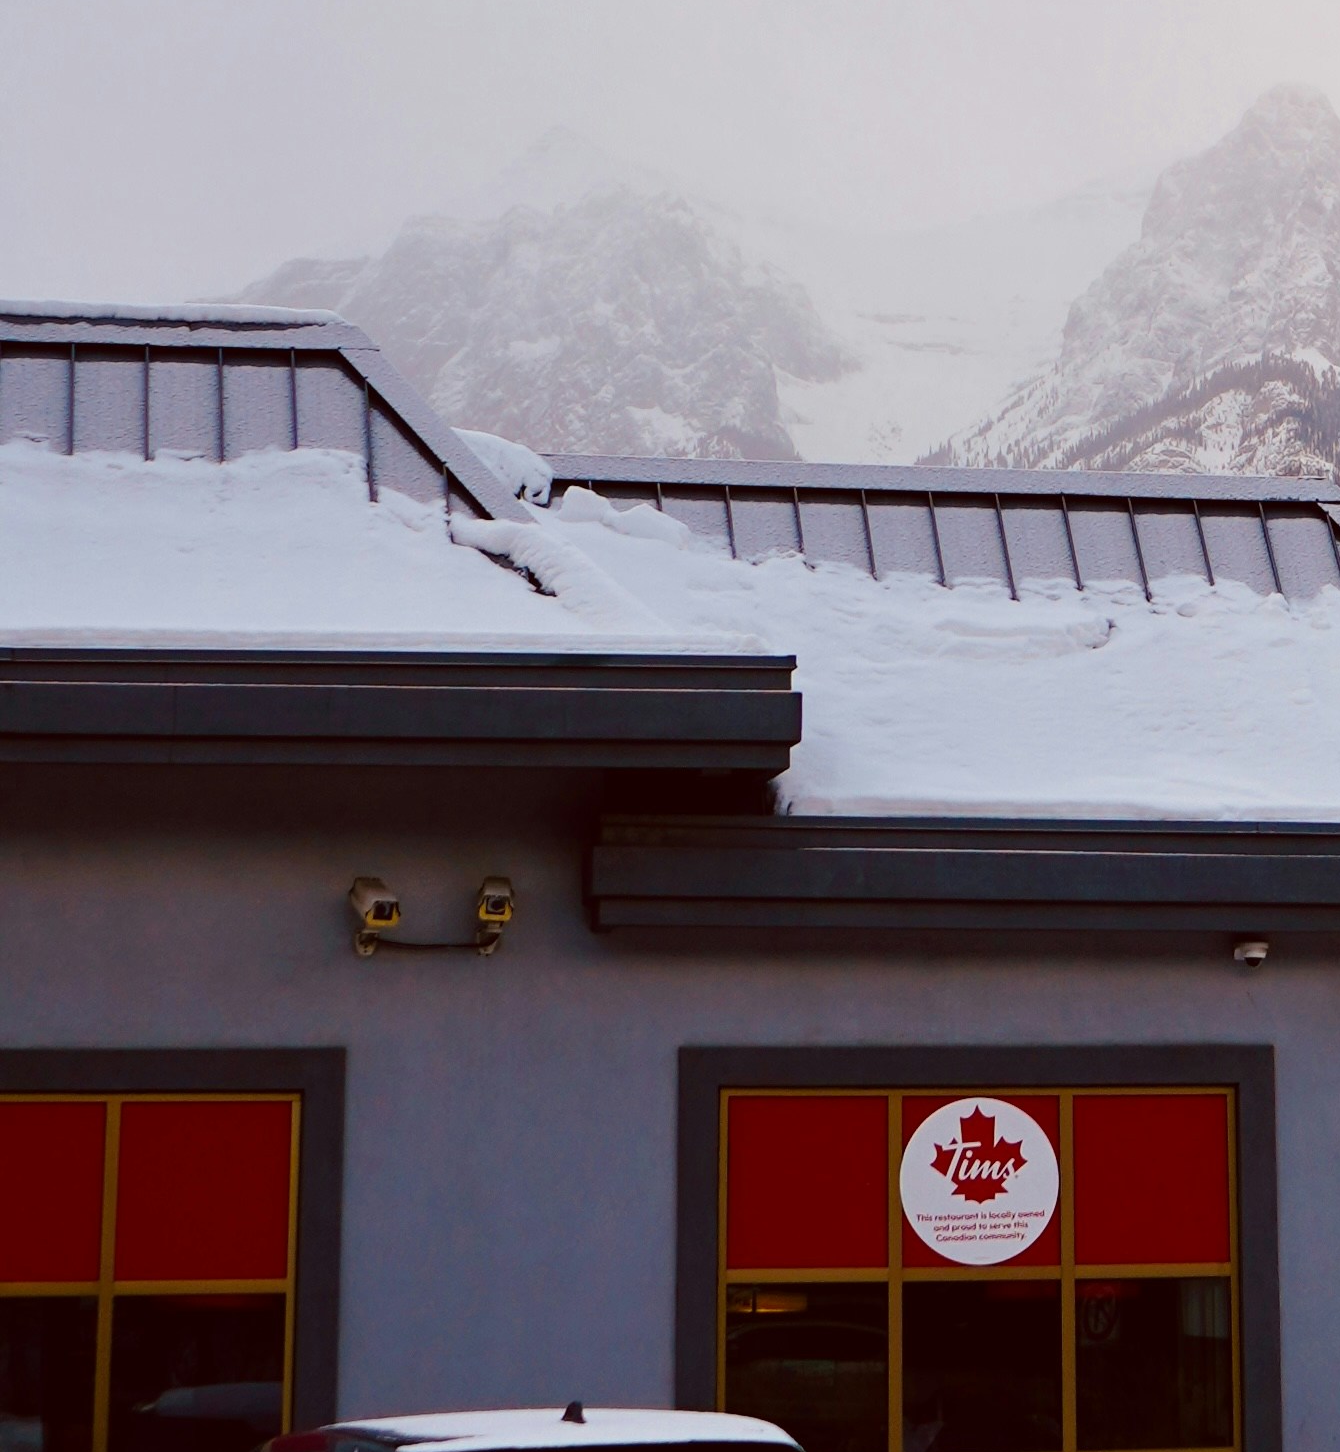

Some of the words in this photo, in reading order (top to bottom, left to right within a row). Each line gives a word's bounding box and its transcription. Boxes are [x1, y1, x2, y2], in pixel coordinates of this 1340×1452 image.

[942, 1141, 1016, 1181] Tims
[917, 1214, 932, 1222] This
[934, 1213, 978, 1221] restaurant
[989, 1211, 1015, 1220] locally
[934, 1224, 949, 1232] and
[952, 1223, 976, 1232] proud
[1014, 1220, 1028, 1228] this
[936, 1234, 977, 1242] Canadian
